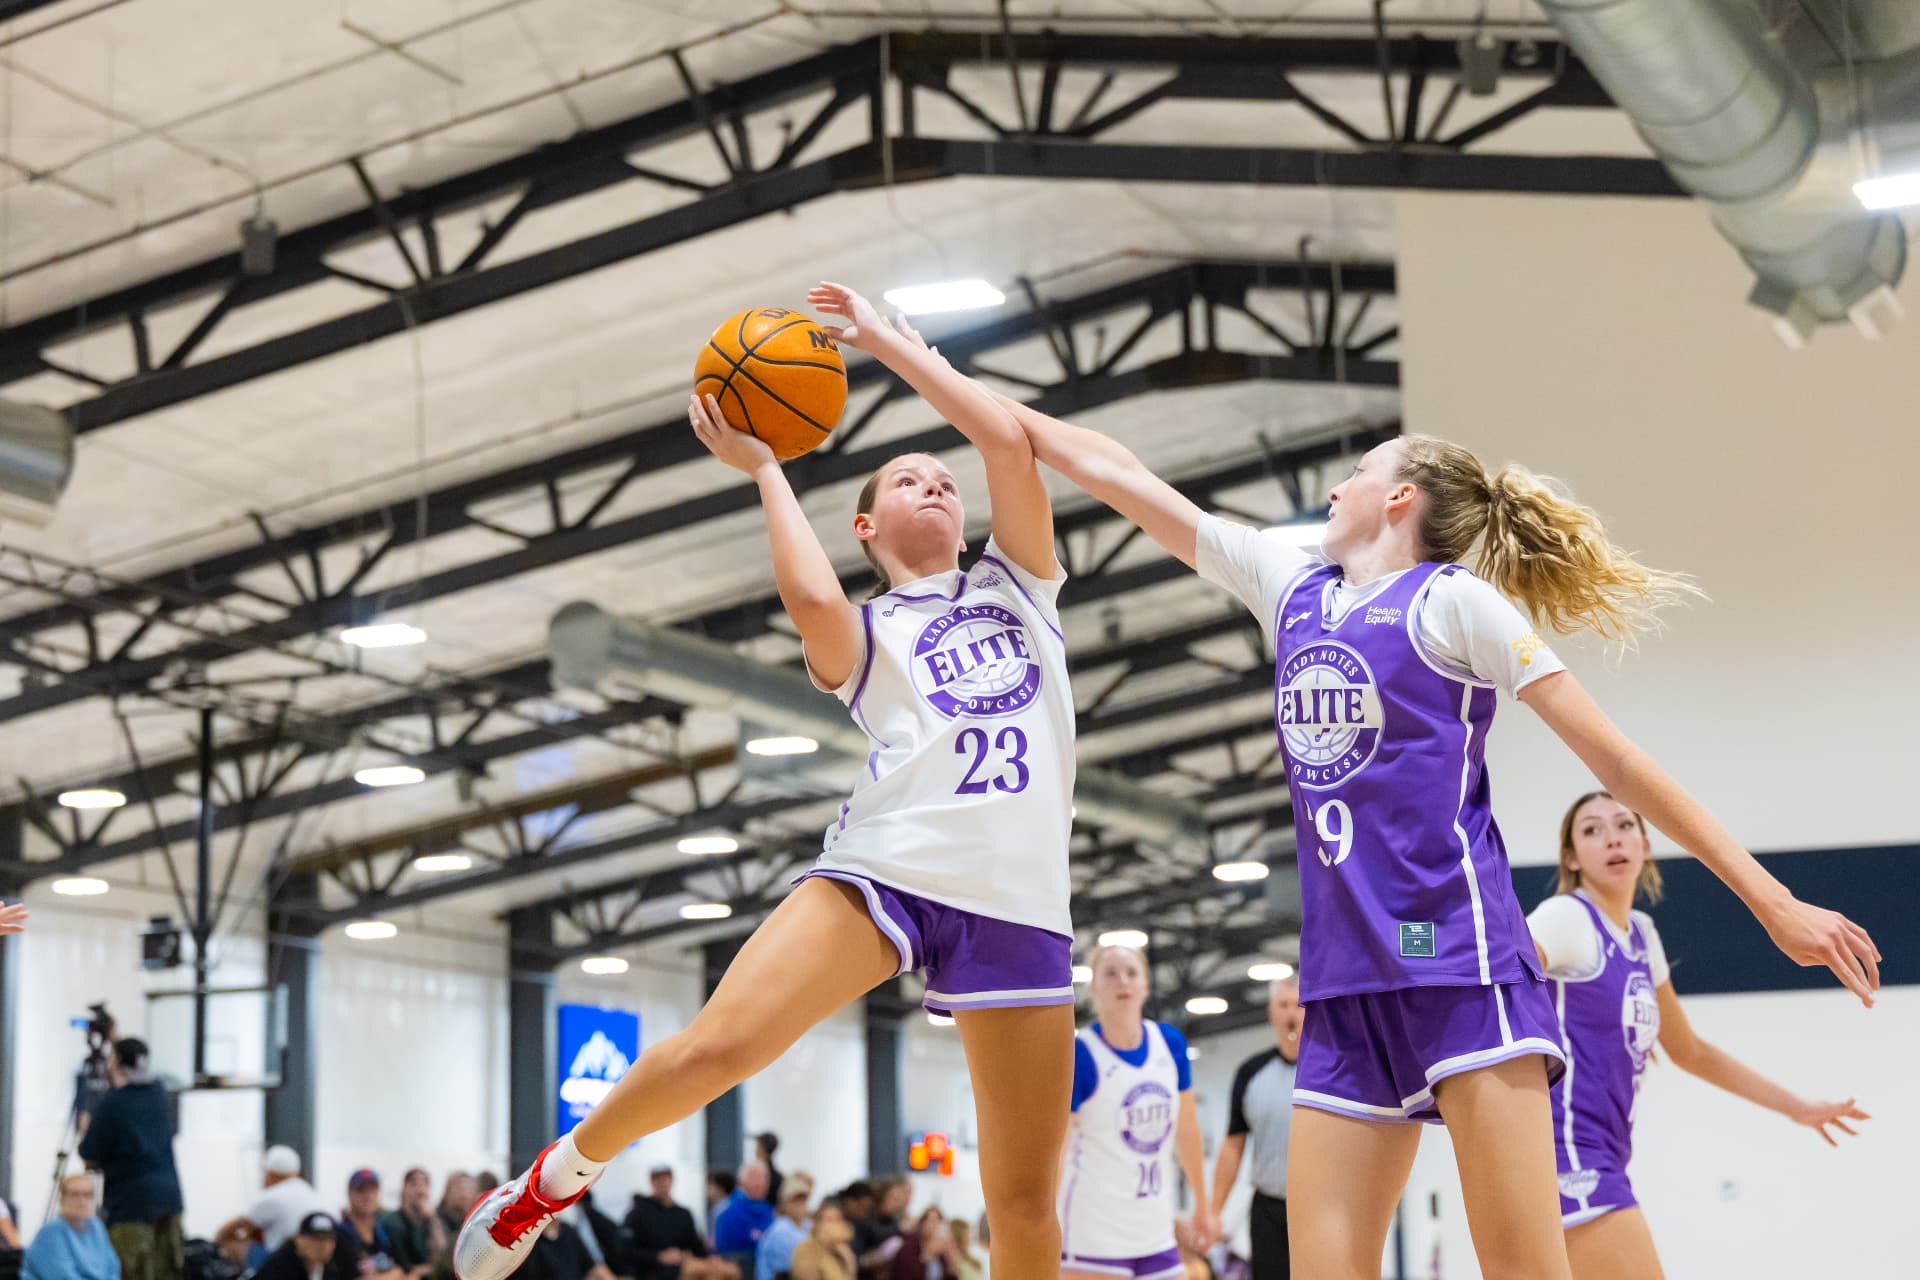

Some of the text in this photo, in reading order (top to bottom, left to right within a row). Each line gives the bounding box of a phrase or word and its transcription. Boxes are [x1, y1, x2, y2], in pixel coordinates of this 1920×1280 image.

[923, 613, 957, 643] LADY
[1364, 614, 1401, 625] Equity
[1367, 606, 1402, 617] Health
[924, 629, 1031, 687] ELITE
[1286, 649, 1360, 679] LADY NOTES
[952, 680, 1035, 714] SOWCASE
[1281, 688, 1365, 725] ELITE
[954, 726, 1030, 794] 23
[1290, 748, 1363, 781] OWCASE
